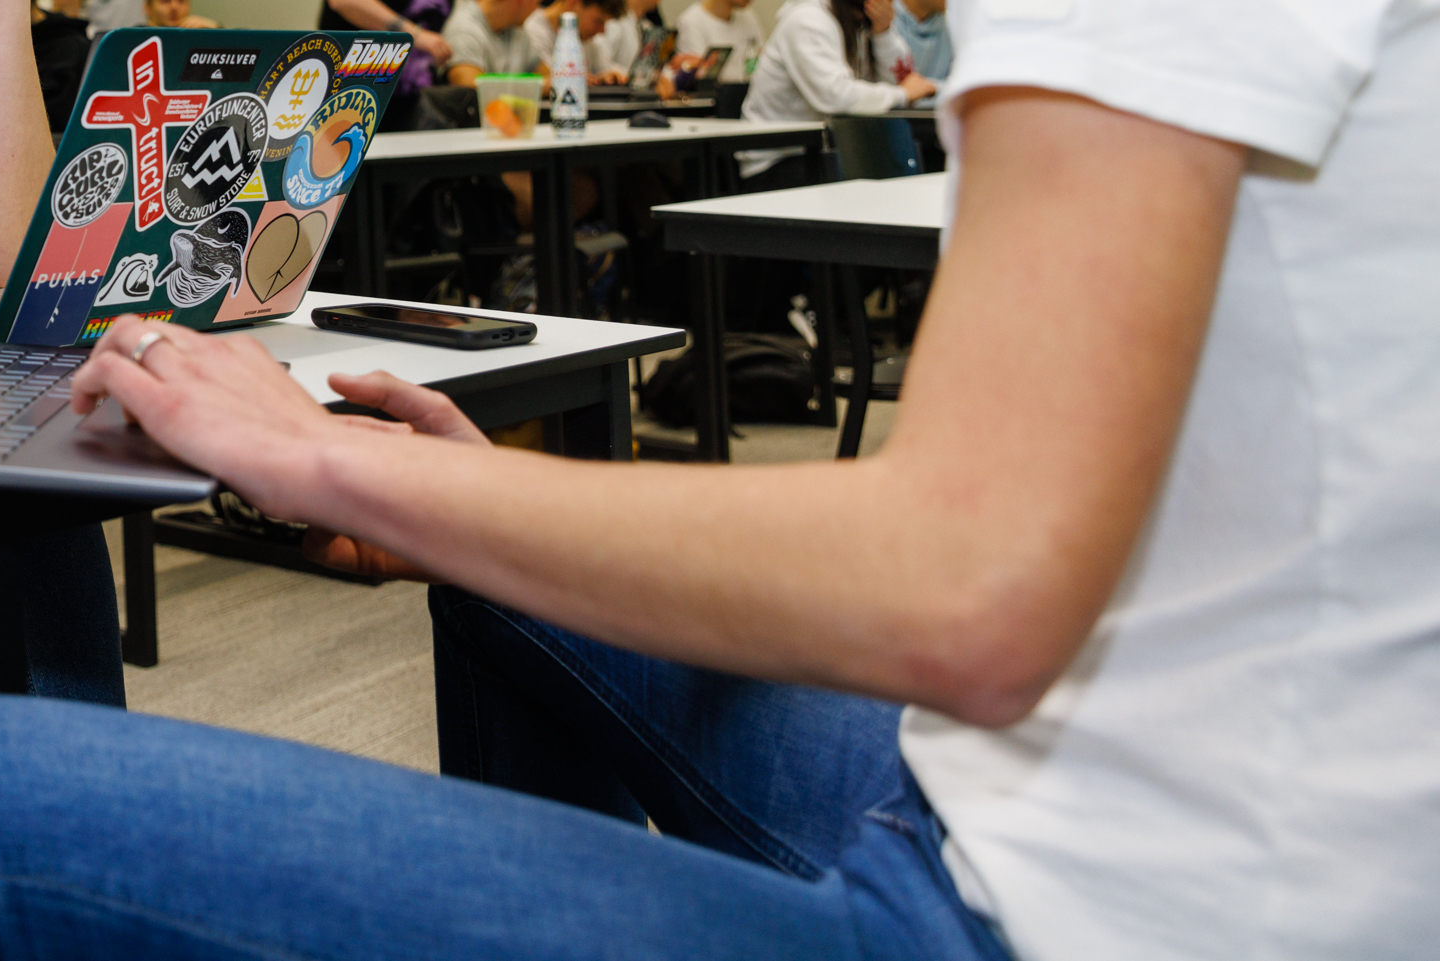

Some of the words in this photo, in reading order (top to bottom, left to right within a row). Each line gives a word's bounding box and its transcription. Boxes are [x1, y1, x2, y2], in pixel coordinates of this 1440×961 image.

[189, 52, 257, 65] QUIKSILVER
[260, 62, 285, 100] HART
[286, 39, 323, 64] BEACH
[335, 43, 412, 80] RIDING
[179, 98, 266, 153] EUROFUNCENTER
[311, 90, 375, 132] RIDING
[58, 159, 124, 212] CURL
[59, 150, 103, 195] RIP
[168, 162, 189, 178] EST
[324, 170, 346, 198] 77
[166, 187, 185, 214] SURF
[179, 205, 189, 219] &
[187, 200, 218, 221] SNOW
[218, 170, 251, 207] STORE
[34, 269, 101, 290] PUKAS
